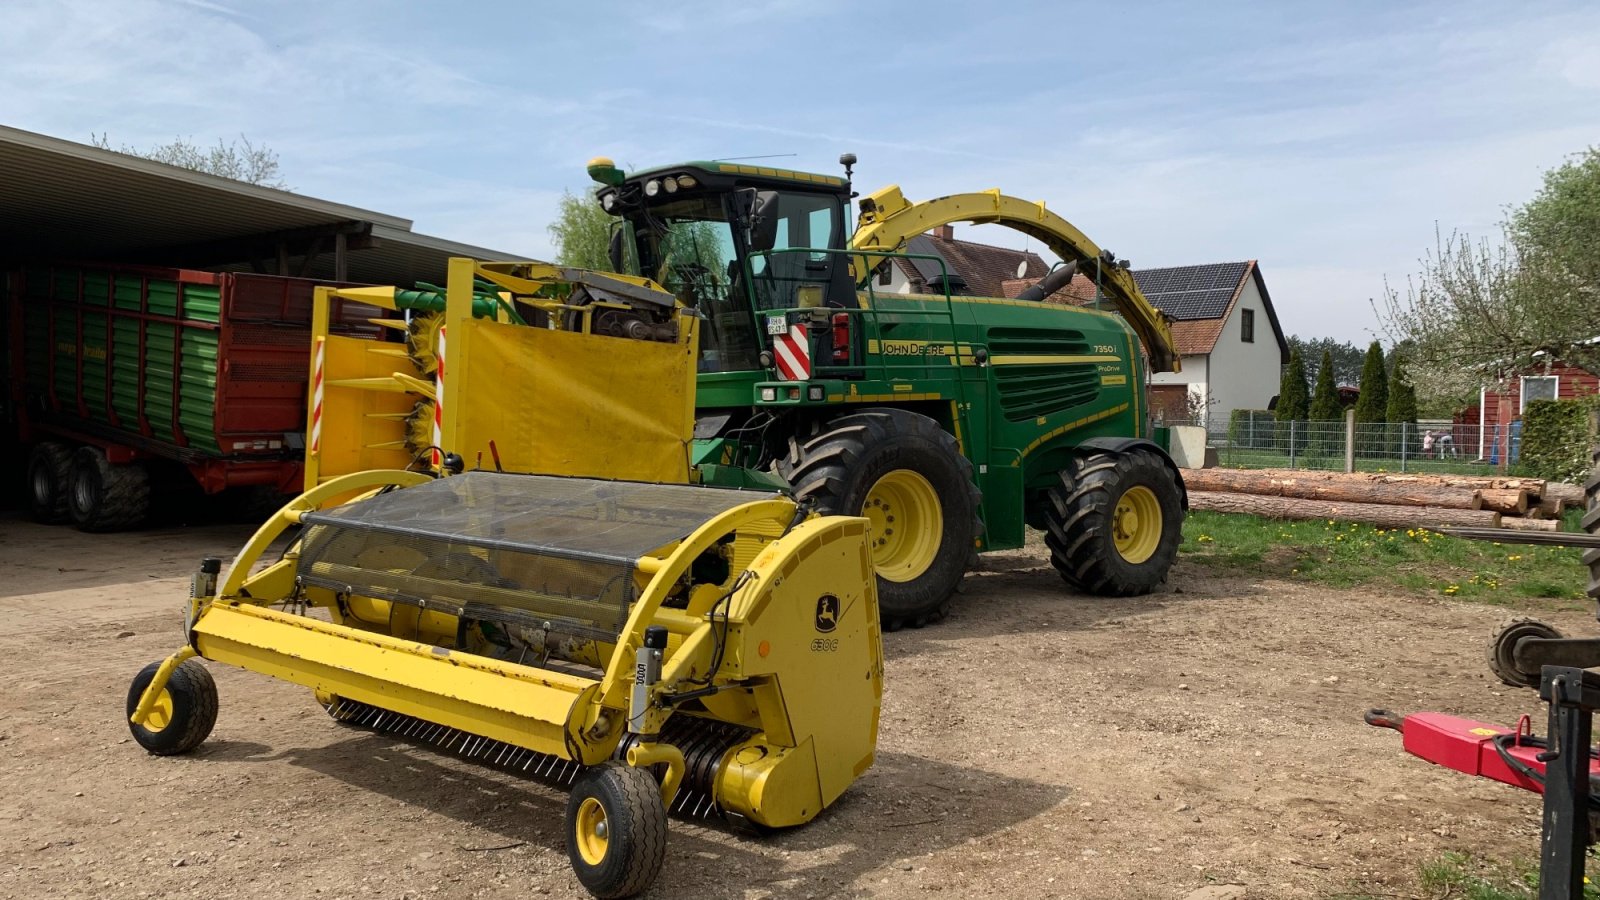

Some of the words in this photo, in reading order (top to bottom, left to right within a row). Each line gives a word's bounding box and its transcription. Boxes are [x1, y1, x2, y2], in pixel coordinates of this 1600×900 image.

[883, 343, 909, 354] JOHN
[910, 343, 945, 354] DEERE
[811, 638, 839, 651] 630C
